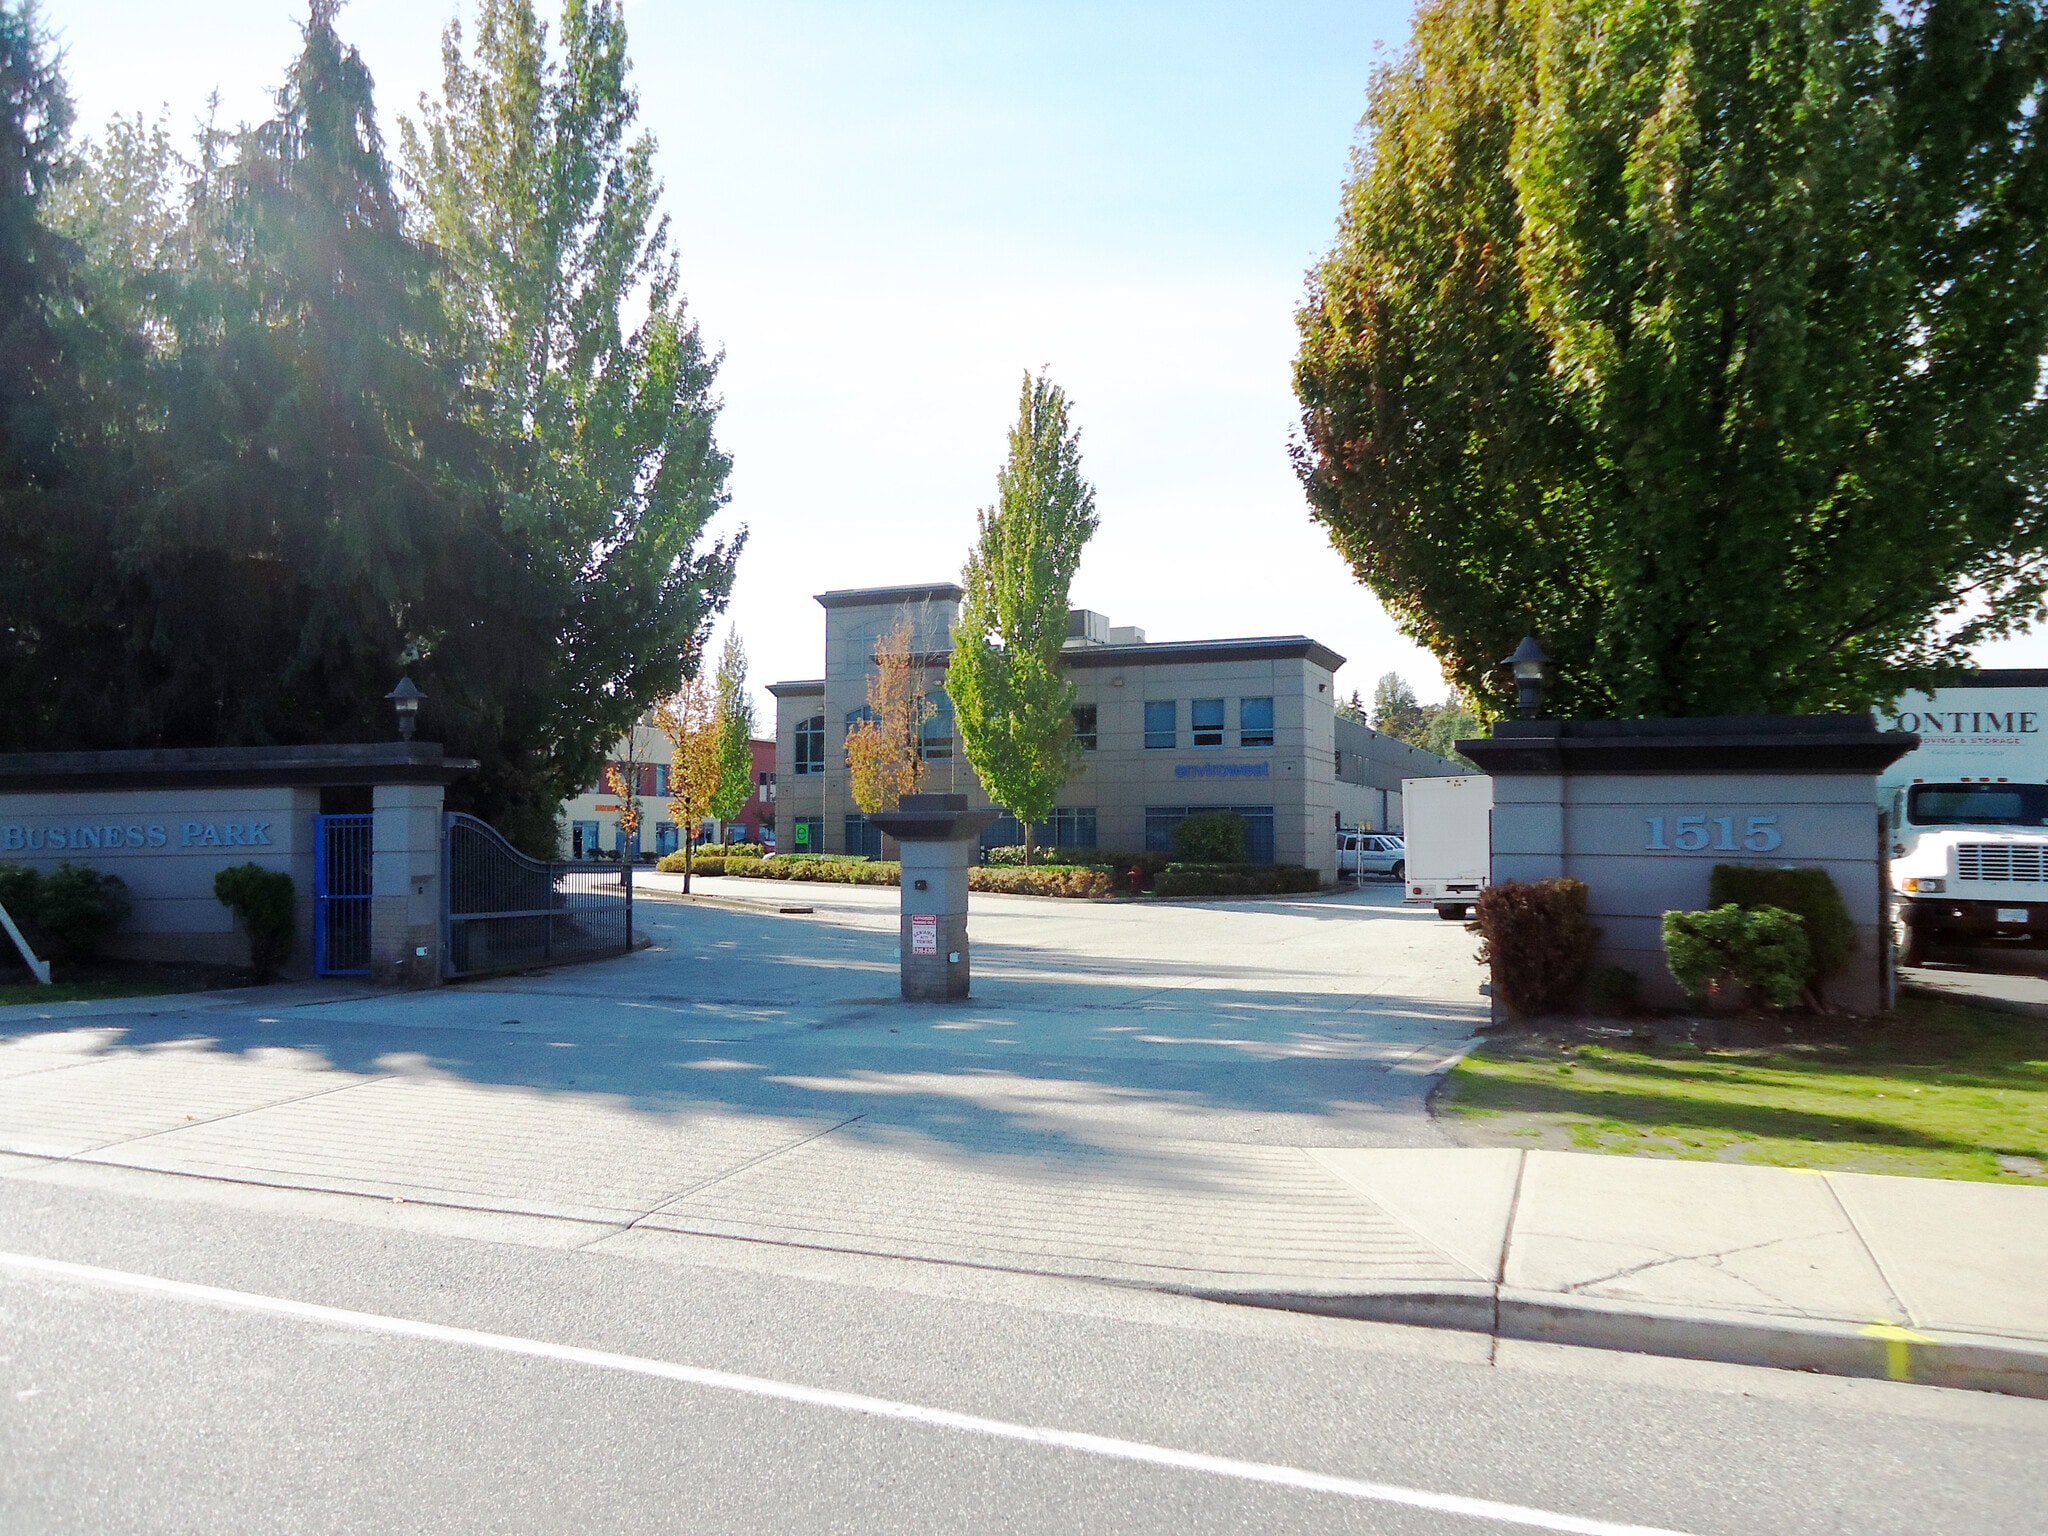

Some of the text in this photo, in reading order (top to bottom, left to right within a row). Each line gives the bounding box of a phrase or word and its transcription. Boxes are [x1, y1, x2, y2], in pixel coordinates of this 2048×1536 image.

[1897, 711, 2039, 733] ONTIME
[1174, 760, 1269, 778] envirowest
[1, 821, 272, 850] BUSINESS PARK
[1645, 814, 1782, 852] 1515
